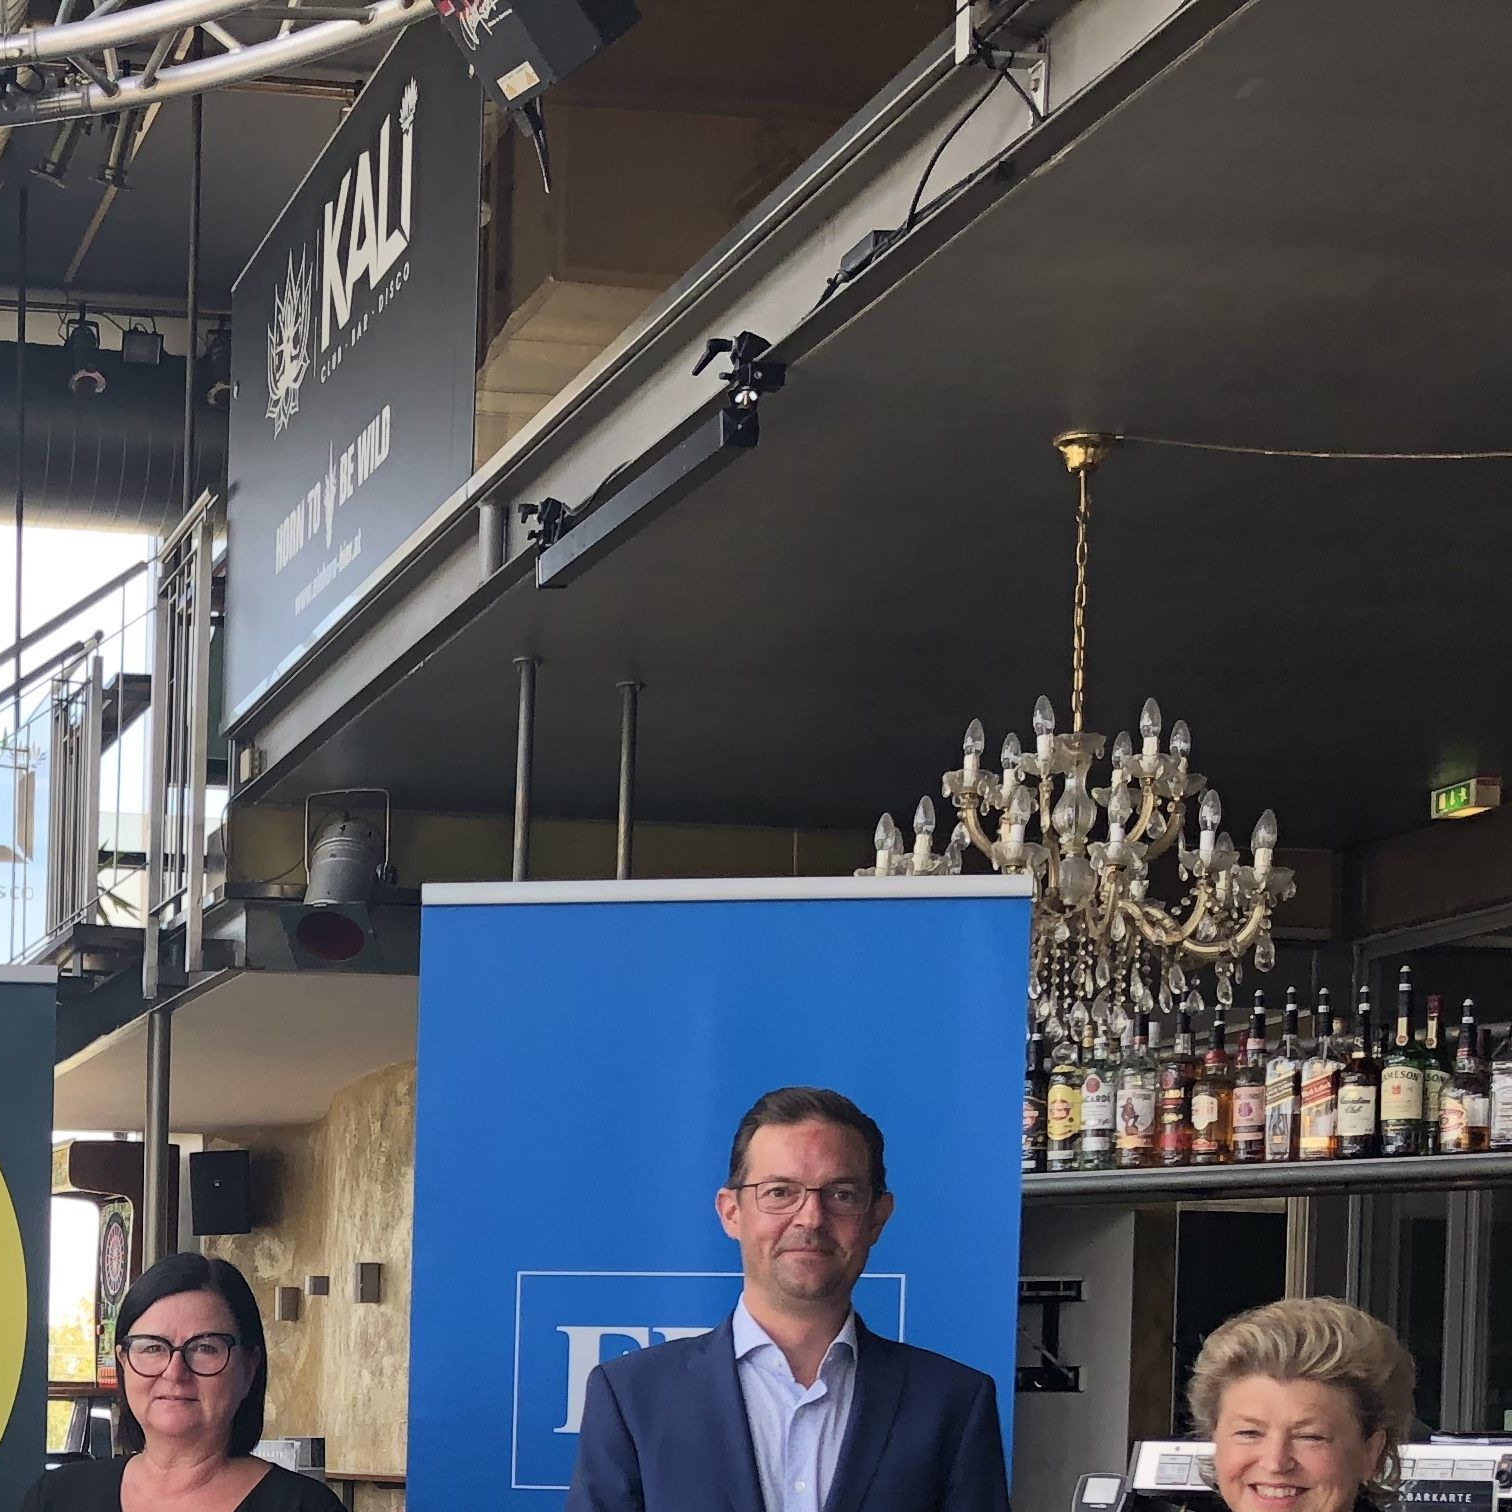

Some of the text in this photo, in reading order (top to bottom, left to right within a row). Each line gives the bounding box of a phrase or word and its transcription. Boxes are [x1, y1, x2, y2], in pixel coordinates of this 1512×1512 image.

[320, 78, 415, 354] KALI
[378, 261, 410, 314] DISCO
[274, 403, 392, 576] HORN TO BE WILD
[1407, 1492, 1472, 1503] BARKARTE
